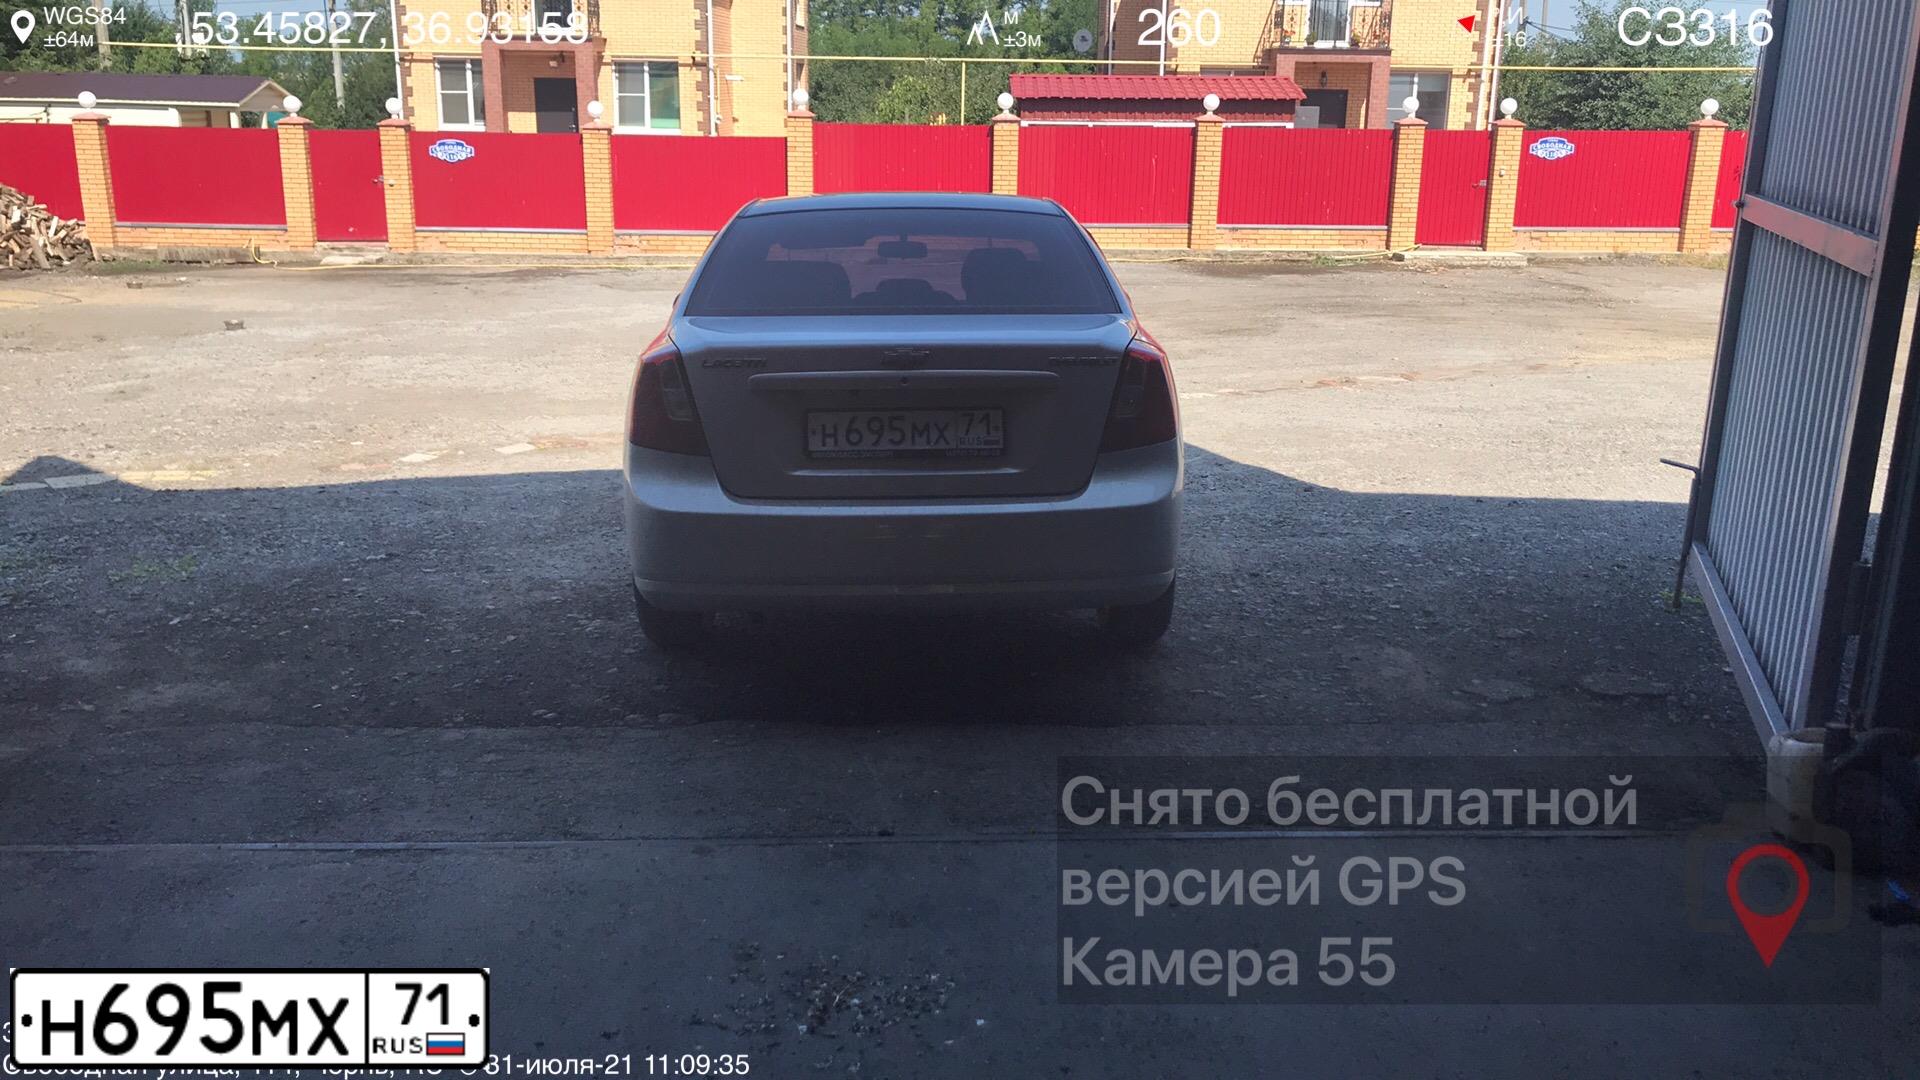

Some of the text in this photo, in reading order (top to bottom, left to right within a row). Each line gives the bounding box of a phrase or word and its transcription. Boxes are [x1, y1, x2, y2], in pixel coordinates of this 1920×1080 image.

[820, 412, 993, 447] Н695МХ 71
[959, 436, 983, 446] RUS
